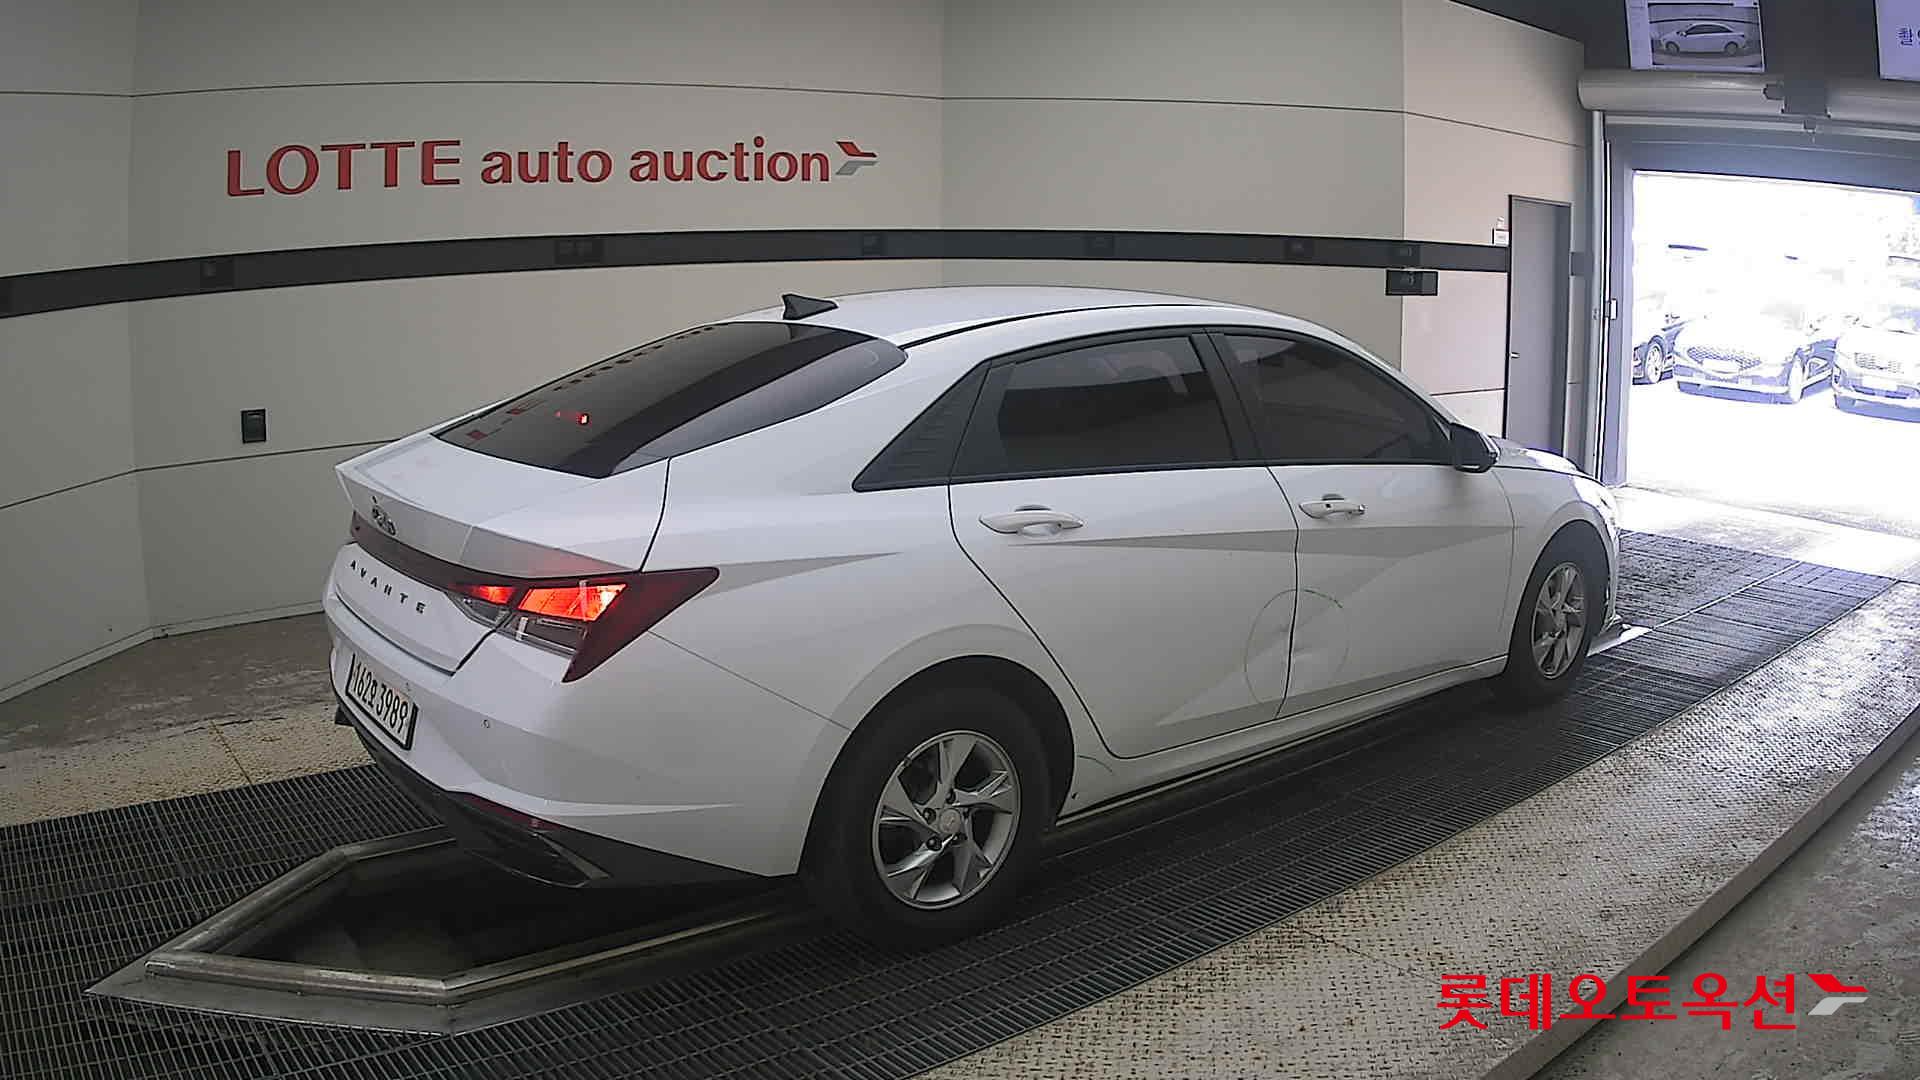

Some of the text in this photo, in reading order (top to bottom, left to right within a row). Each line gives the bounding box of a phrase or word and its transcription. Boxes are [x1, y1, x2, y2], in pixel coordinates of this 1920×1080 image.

[227, 136, 830, 197] LOTTE auto auction
[350, 560, 426, 614] AVANTE
[376, 682, 409, 734] 3989
